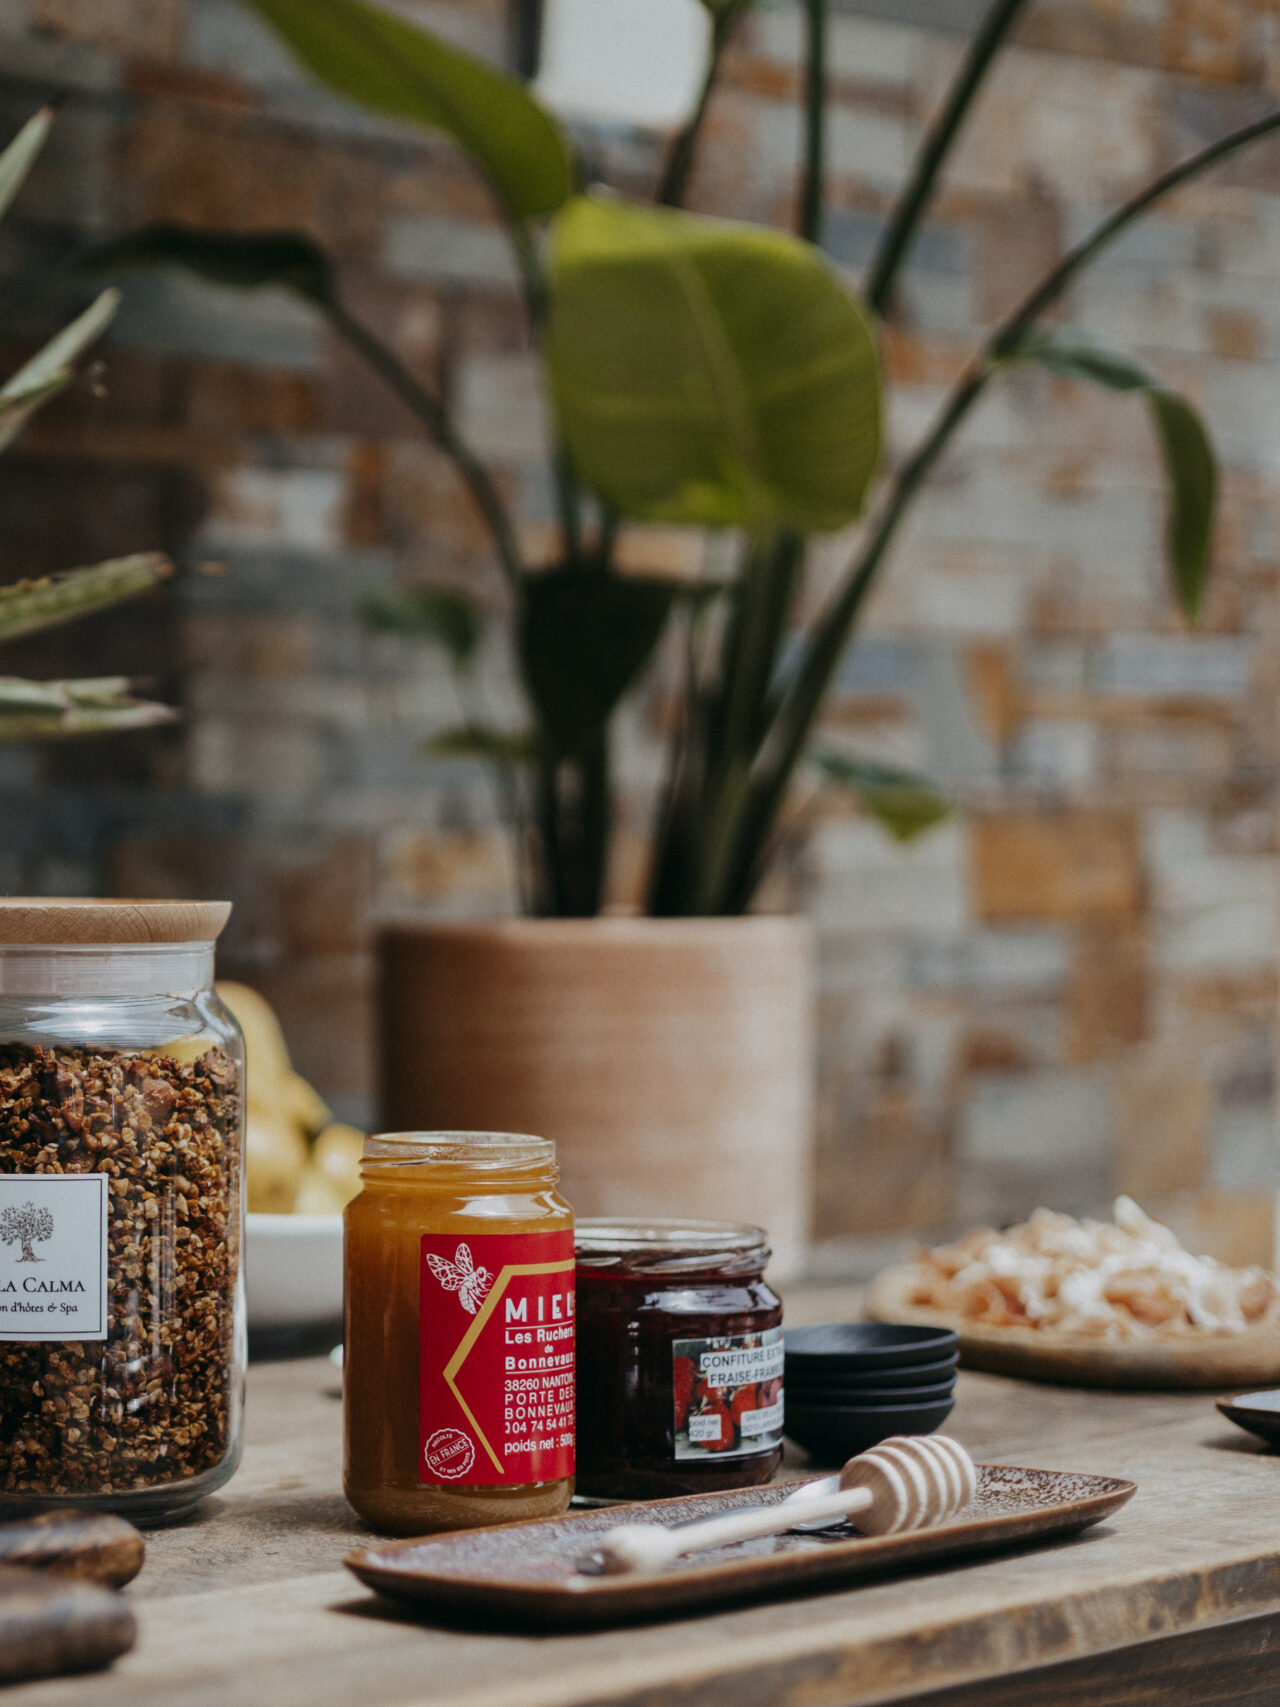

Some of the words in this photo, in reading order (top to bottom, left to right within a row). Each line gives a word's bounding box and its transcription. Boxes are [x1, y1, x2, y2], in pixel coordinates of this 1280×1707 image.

[23, 1277, 86, 1292] CALMA
[10, 1301, 44, 1313] d'hôtes
[47, 1303, 58, 1313] &
[60, 1302, 78, 1316] Spa
[505, 1292, 573, 1323] MIEL
[505, 1330, 532, 1344] Les
[544, 1344, 554, 1353] de
[702, 1351, 764, 1368] CONFITURE
[504, 1378, 540, 1391] 38260
[505, 1390, 555, 1405] PORTE
[559, 1385, 573, 1400] DES
[530, 1420, 543, 1432] 74
[546, 1418, 557, 1431] 54
[558, 1416, 567, 1427] 41
[428, 1454, 441, 1465] EN
[439, 1438, 469, 1459] FRANCE
[504, 1439, 536, 1456] poids
[539, 1436, 554, 1450] net
